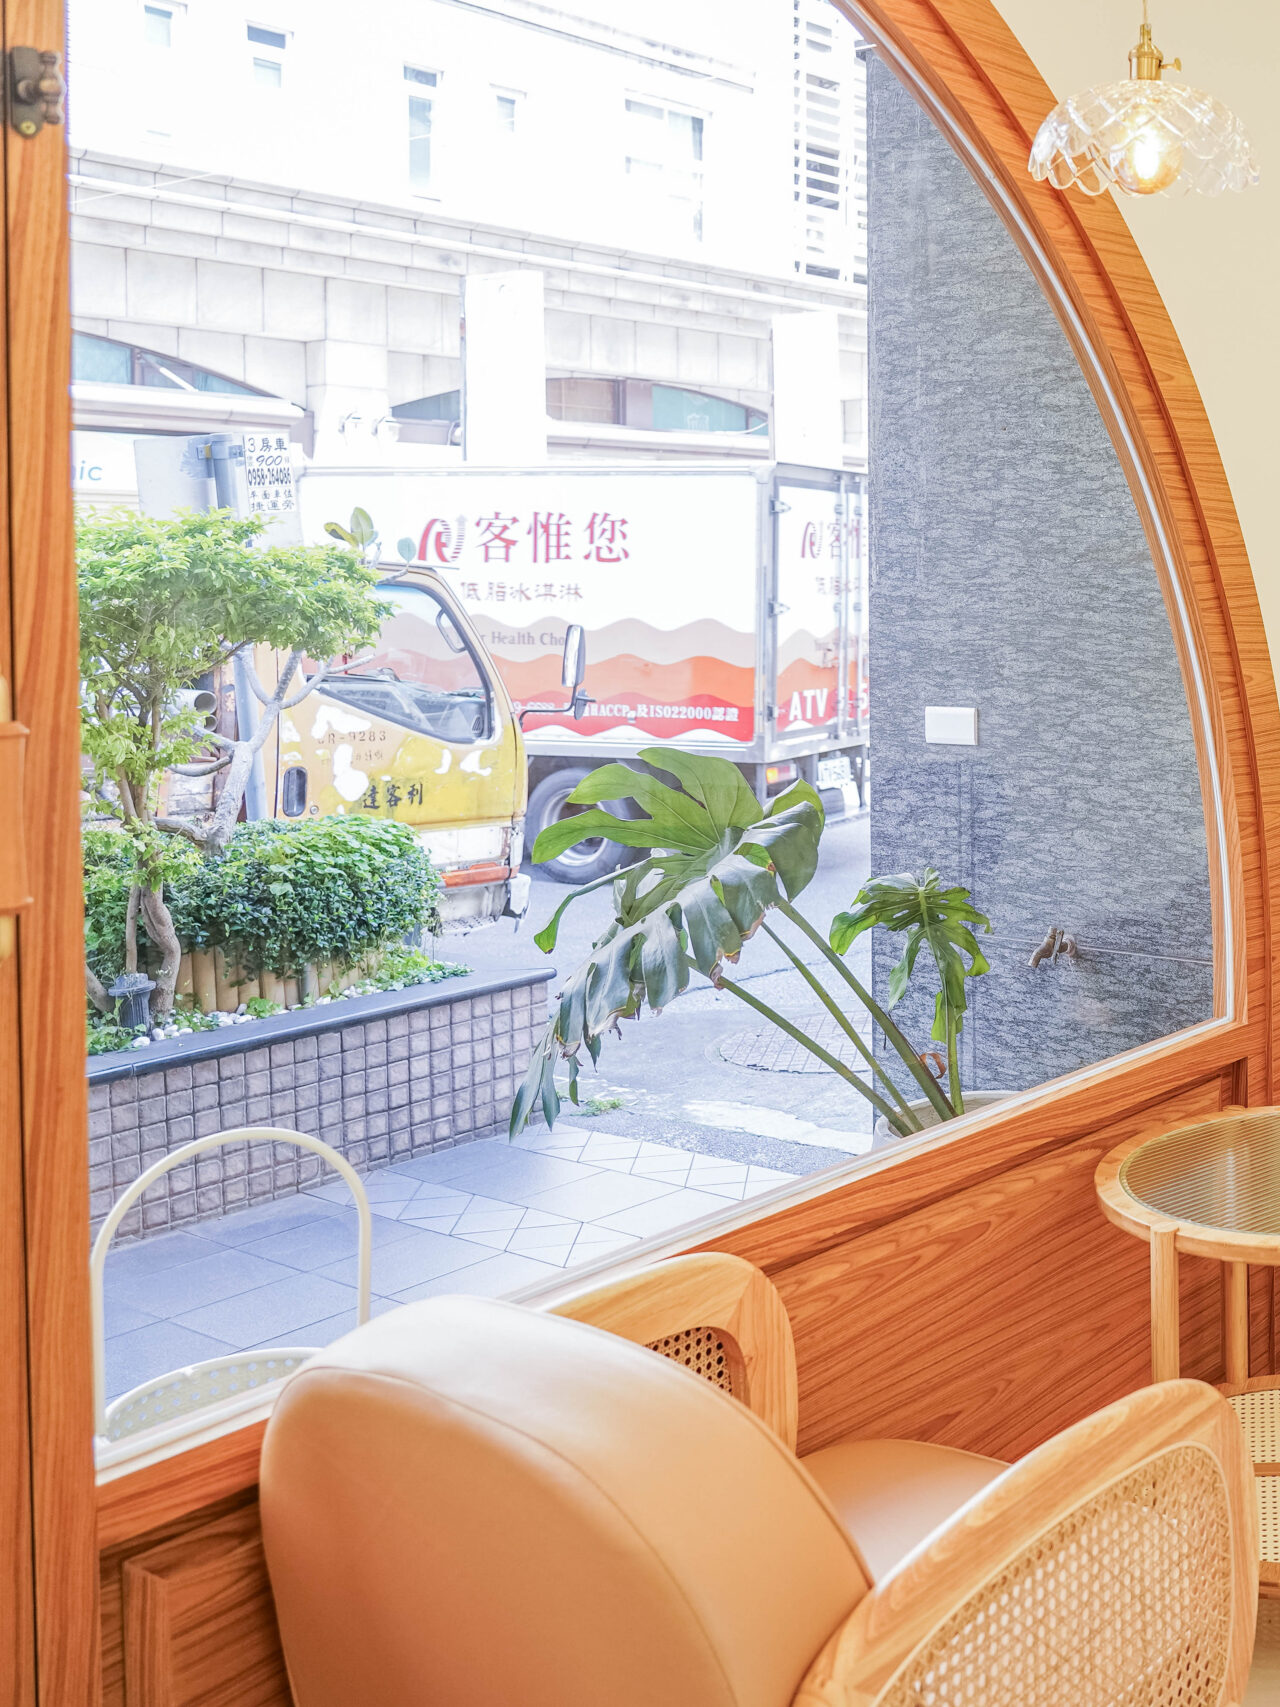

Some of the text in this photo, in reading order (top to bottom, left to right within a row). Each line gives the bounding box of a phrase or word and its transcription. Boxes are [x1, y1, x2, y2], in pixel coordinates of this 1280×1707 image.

[72, 460, 103, 481] ic
[256, 455, 283, 467] 900
[475, 511, 630, 564] 客惟您
[460, 582, 584, 602] 低脂冰淇淋
[491, 631, 536, 646] Health
[540, 632, 565, 647] Cho
[788, 687, 829, 721] ATV
